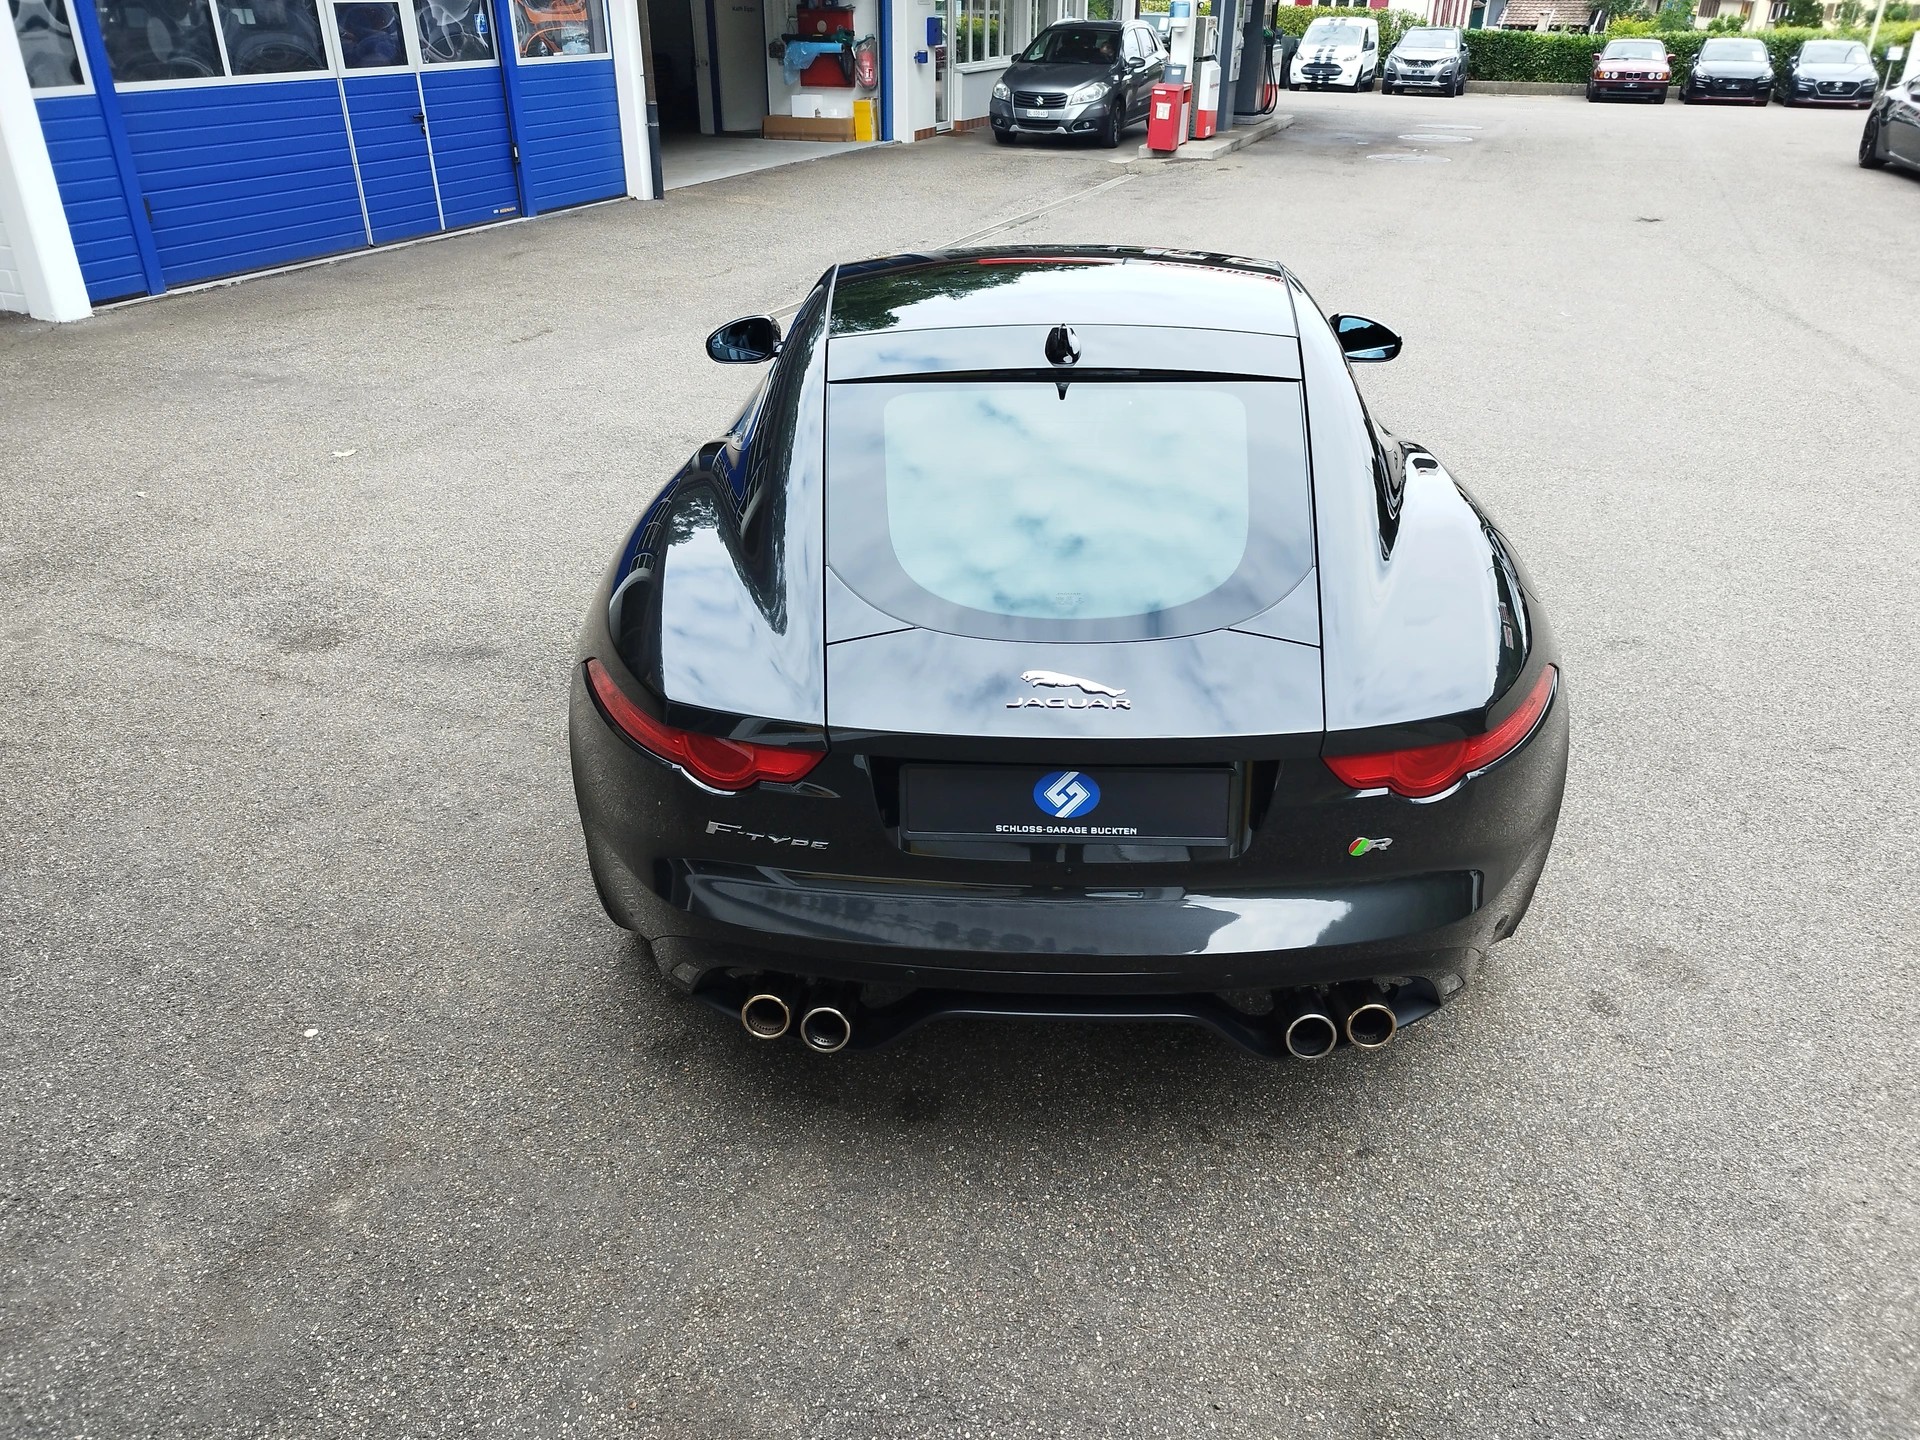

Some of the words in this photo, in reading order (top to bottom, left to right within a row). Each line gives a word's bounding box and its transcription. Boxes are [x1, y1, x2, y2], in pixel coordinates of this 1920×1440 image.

[1006, 697, 1131, 710] JAGUAR
[995, 825, 1087, 834] SCHLOSS-GARAGE
[1091, 827, 1137, 835] BUCKTEN
